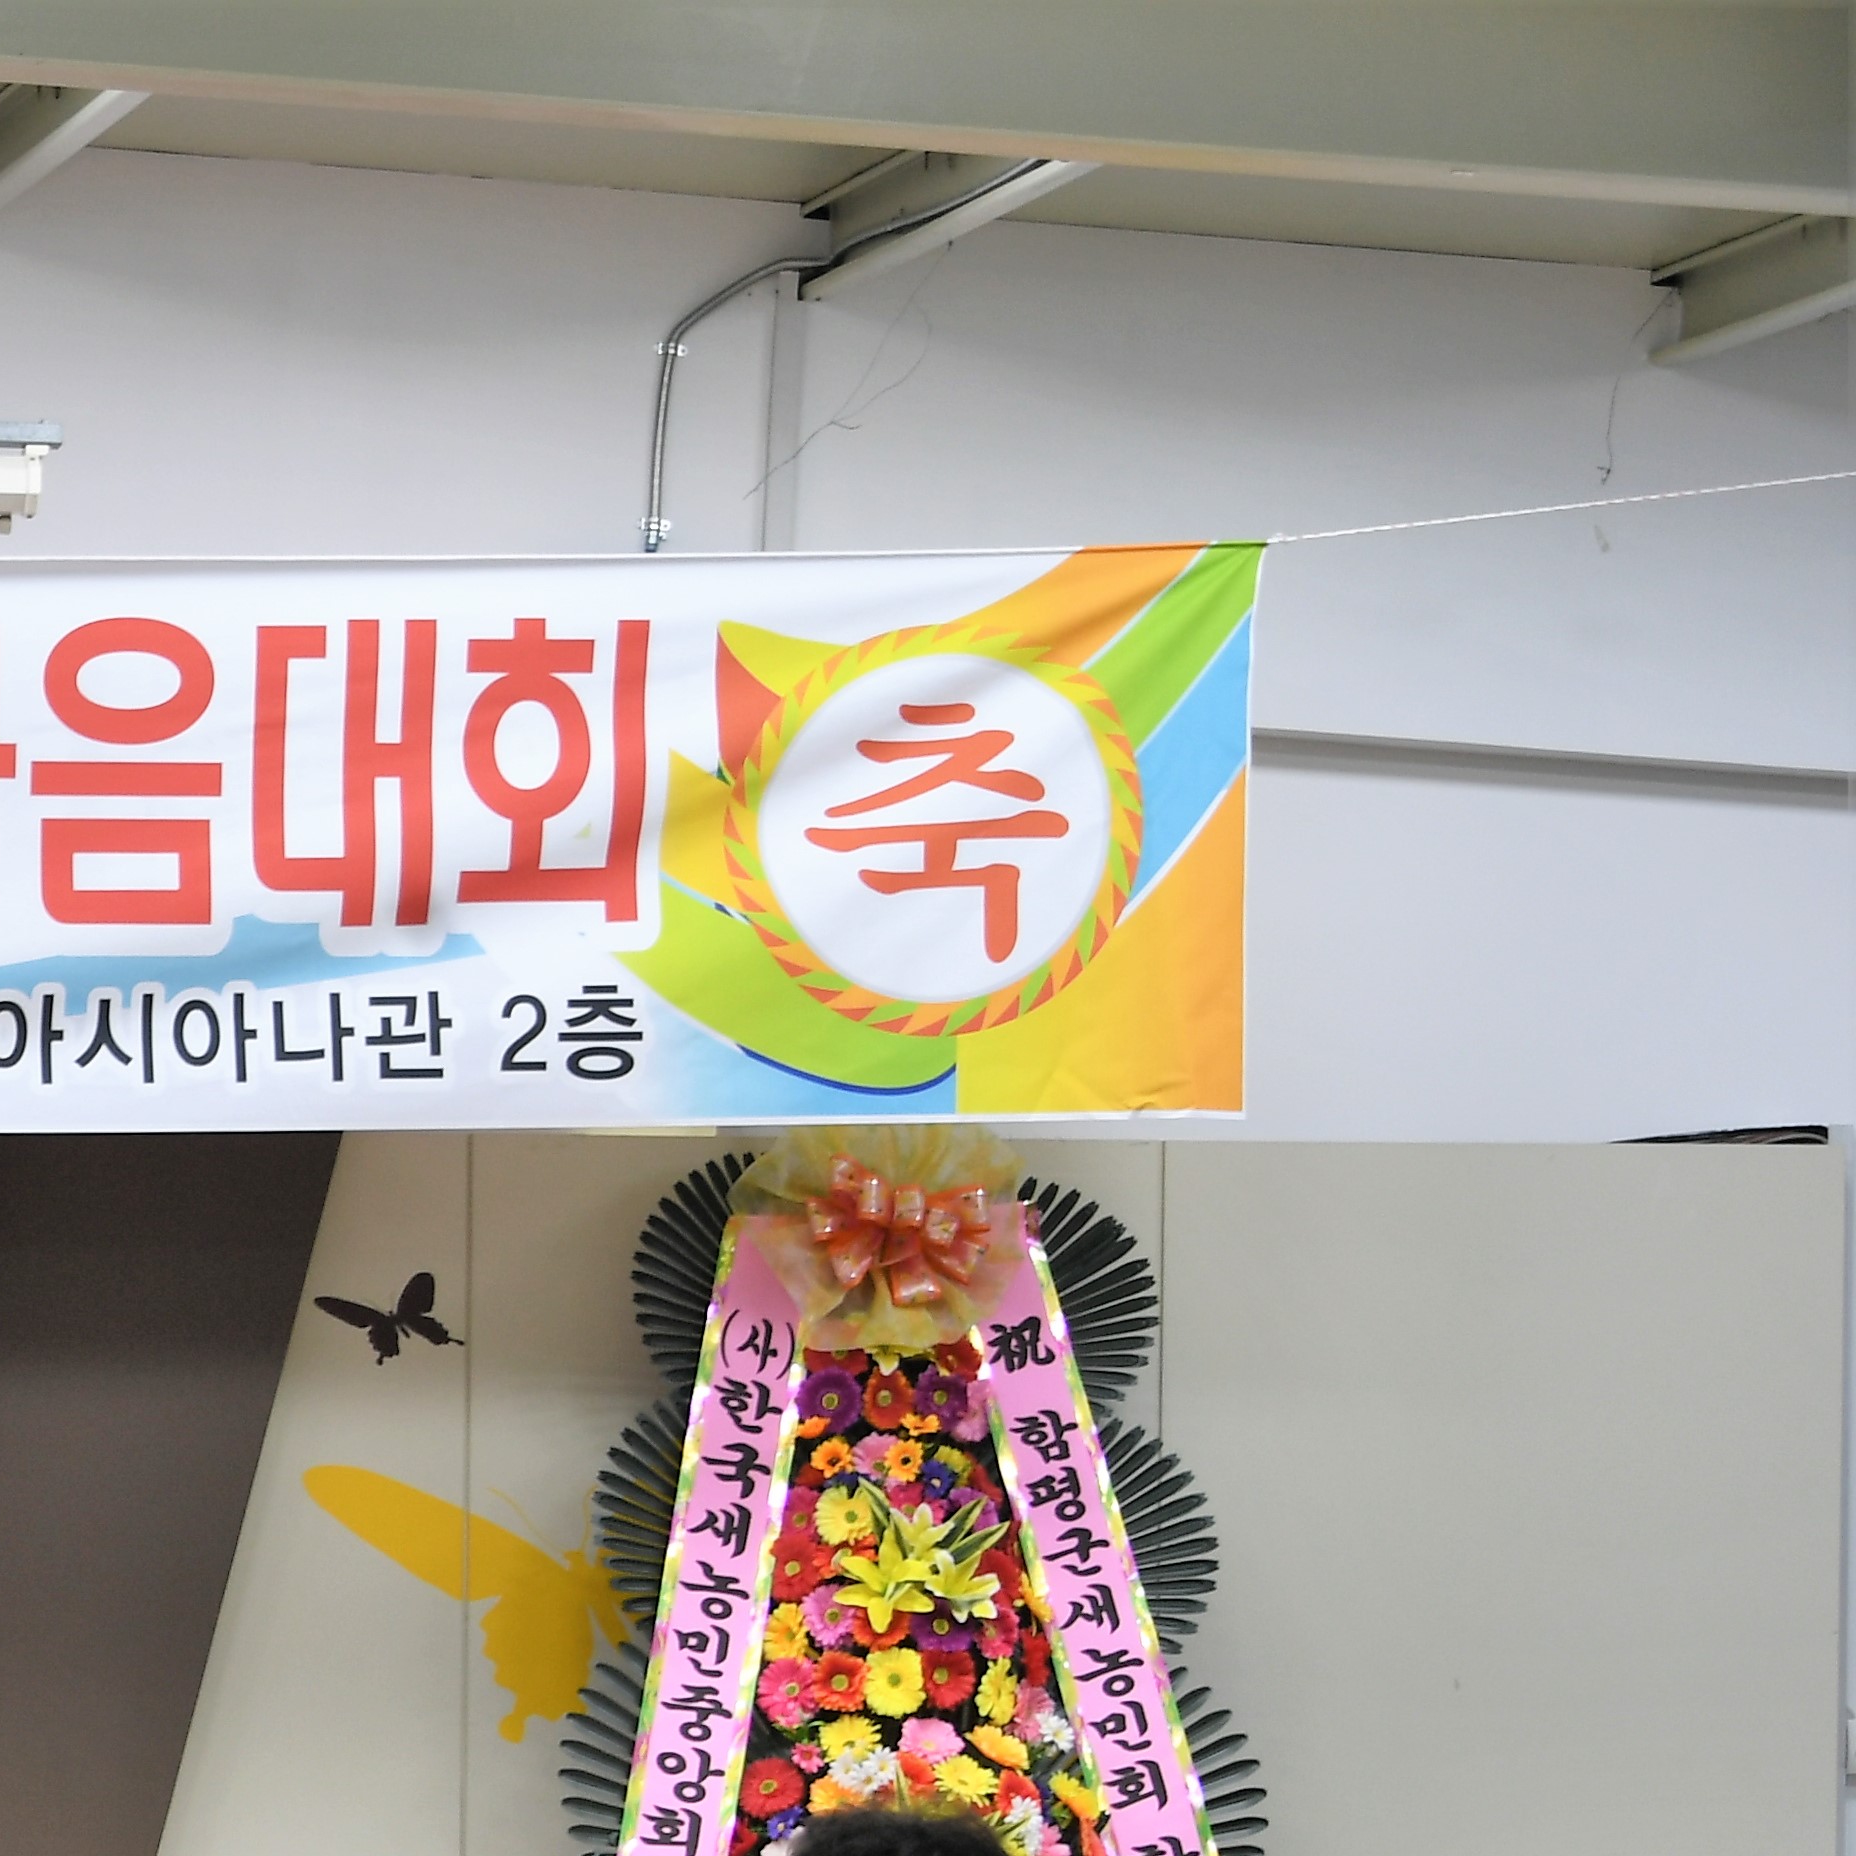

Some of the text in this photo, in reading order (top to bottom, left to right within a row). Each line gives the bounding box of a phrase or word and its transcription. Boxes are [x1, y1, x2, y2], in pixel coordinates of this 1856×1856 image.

[803, 702, 1073, 965] 축
[499, 984, 644, 1082] 2층
[986, 1314, 1058, 1373] 祝
[1008, 1408, 1170, 1815] 함평군새농민회
